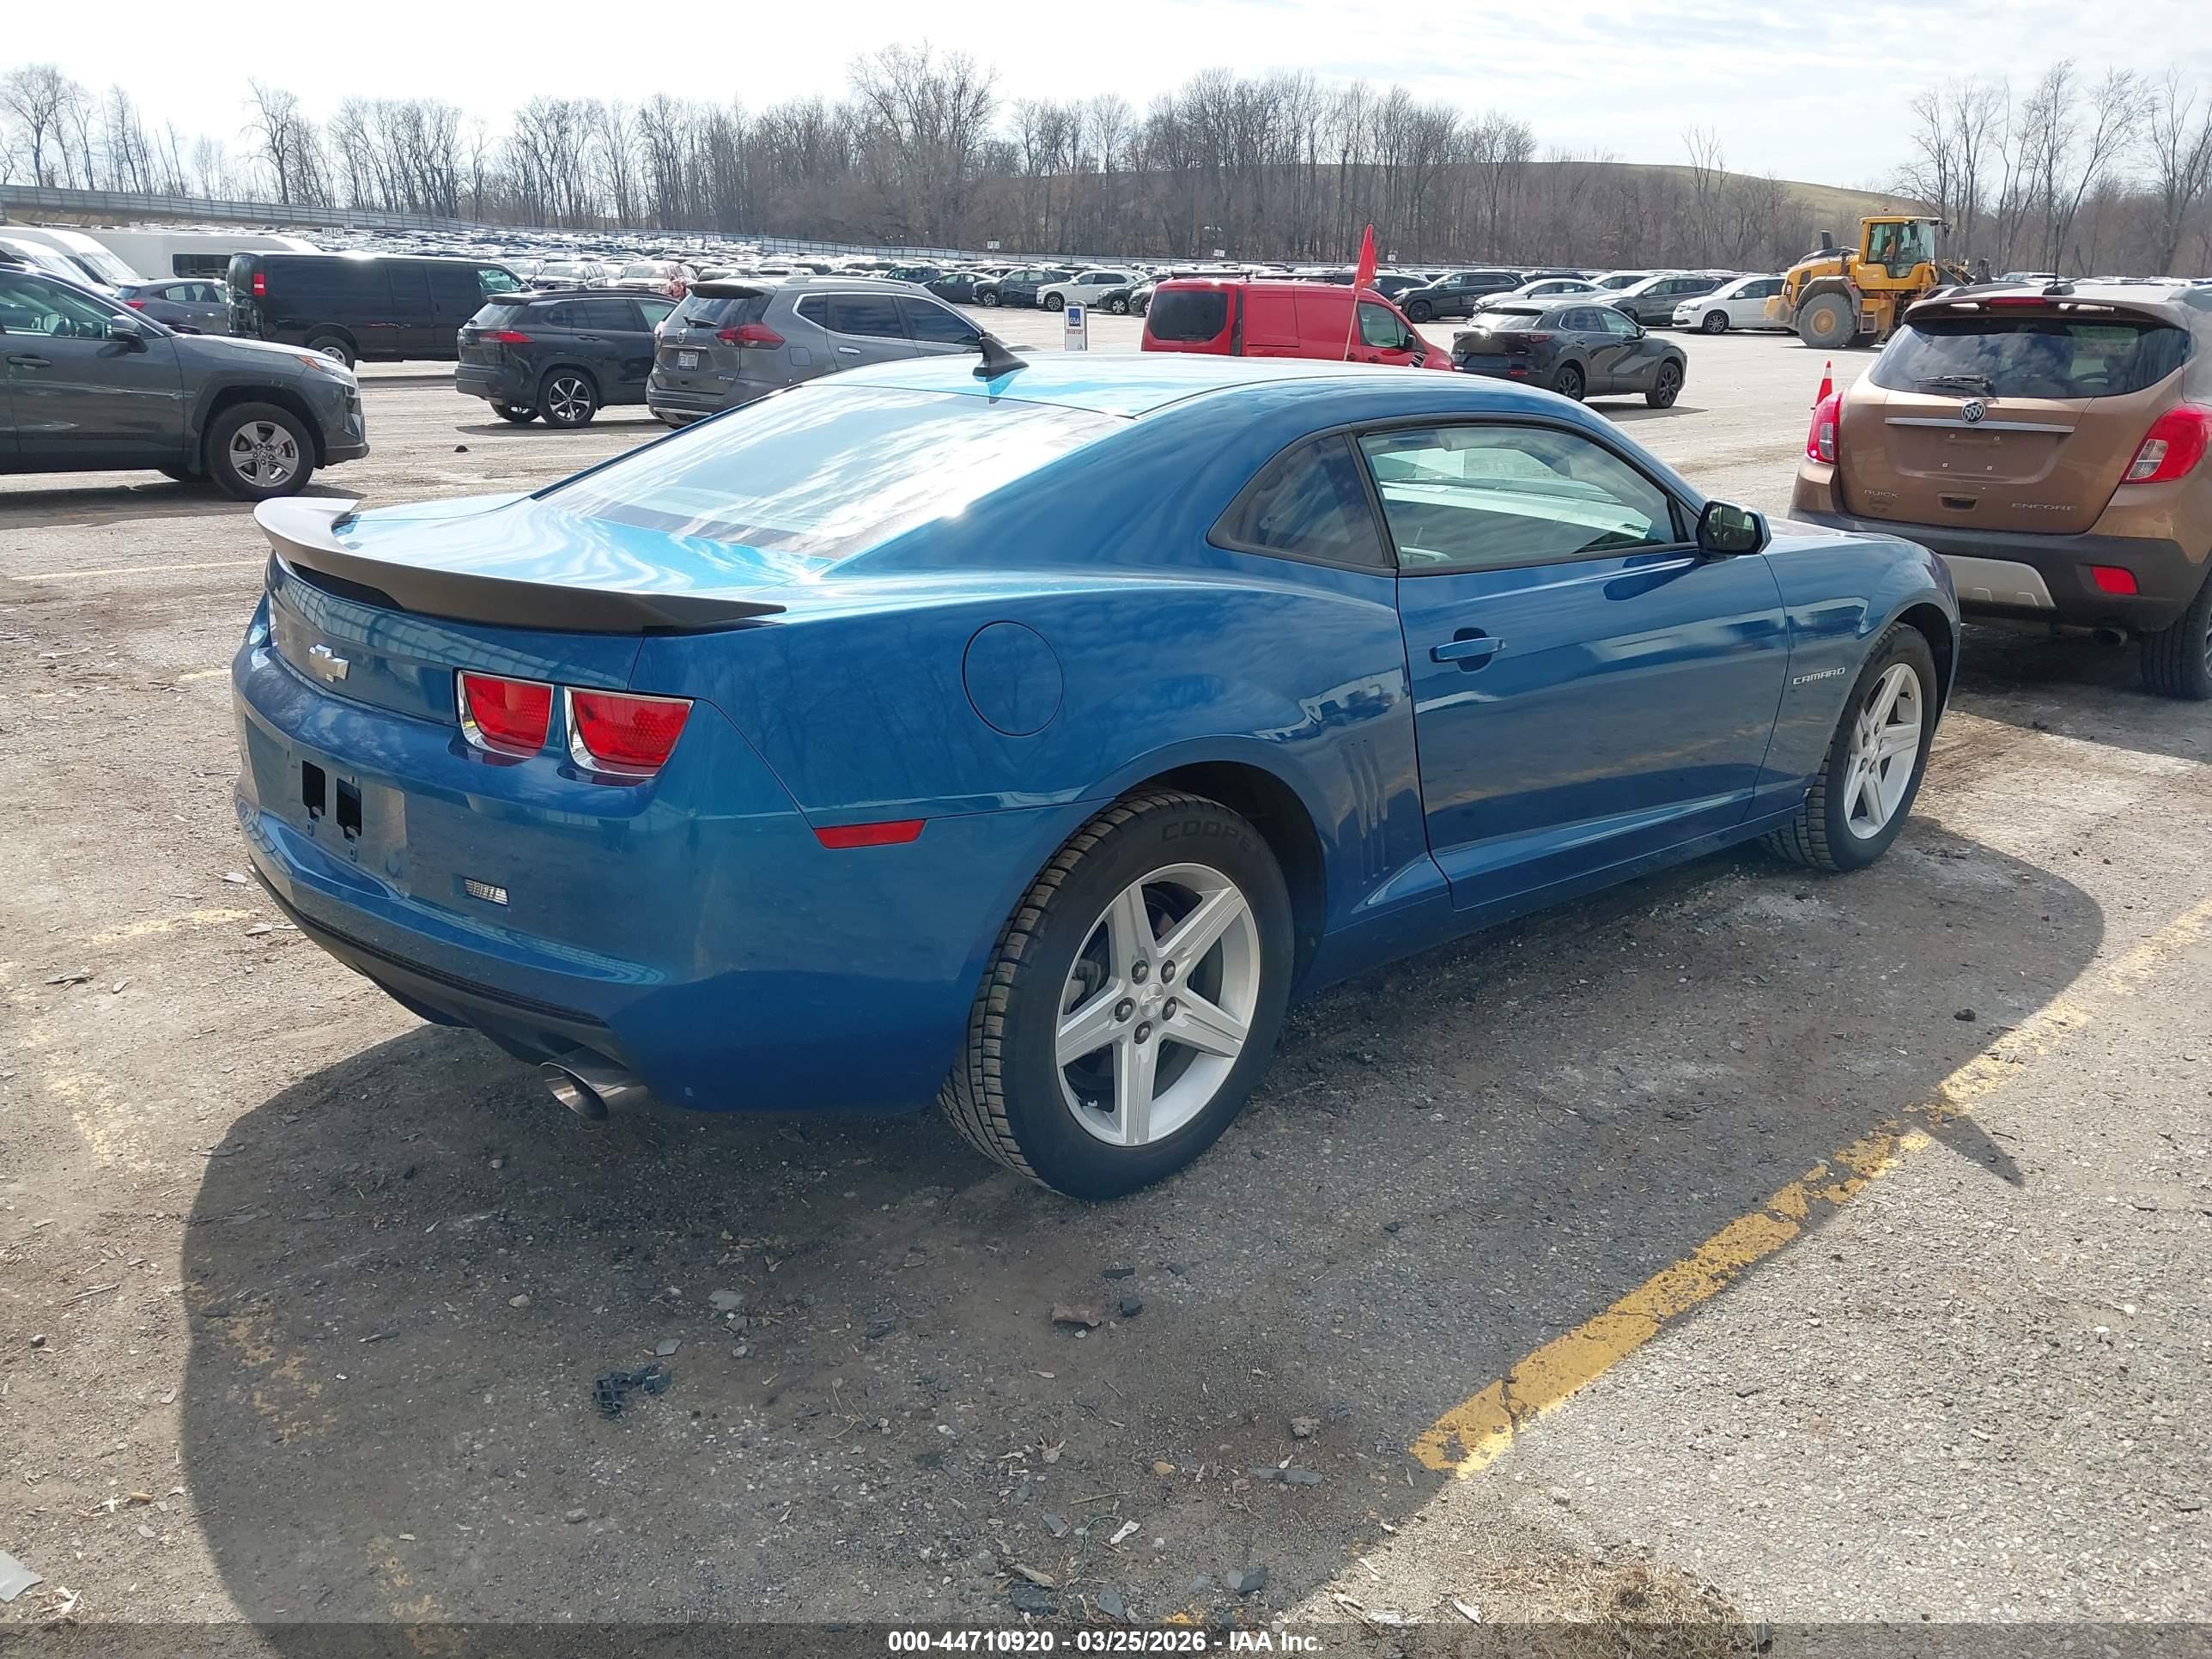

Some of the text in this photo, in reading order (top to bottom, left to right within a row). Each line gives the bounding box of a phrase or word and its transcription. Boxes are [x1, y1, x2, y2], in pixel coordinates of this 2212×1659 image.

[1863, 489, 1900, 499] BUICK
[2012, 502, 2075, 511] ENCORE
[1792, 666, 1845, 685] CAMARO
